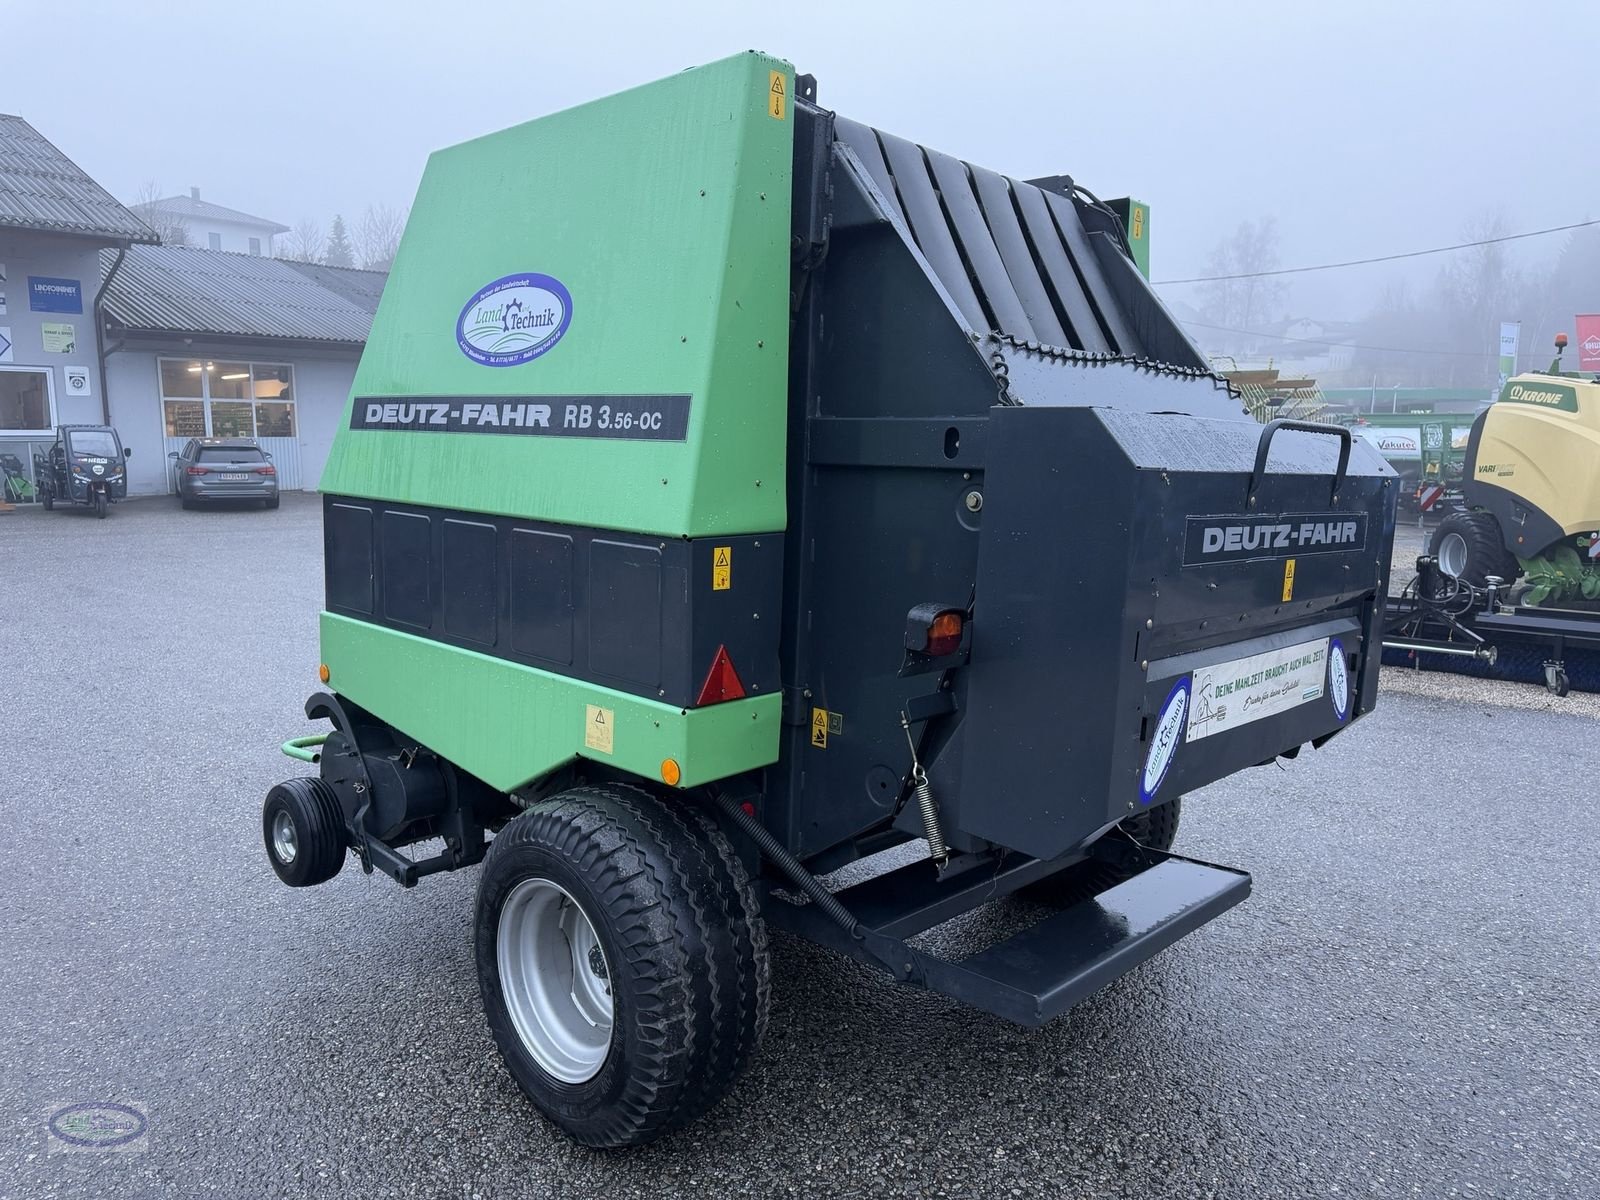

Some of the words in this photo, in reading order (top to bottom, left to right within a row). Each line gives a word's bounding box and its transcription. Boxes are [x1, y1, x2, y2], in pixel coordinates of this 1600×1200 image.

[475, 303, 504, 325] Land
[511, 308, 555, 330] Technik
[1520, 390, 1563, 404] KRONE
[365, 403, 552, 428] DEUTZ-FAHR
[563, 406, 592, 429] RB
[597, 405, 663, 430] 3.56-OC
[1202, 521, 1357, 553] DEUTZ-FAHR
[1215, 682, 1234, 699] DEINE
[1234, 672, 1264, 692] MAHLZEIT
[1265, 663, 1288, 680] BRAUCHT
[1289, 659, 1302, 673] AUCH
[1302, 655, 1312, 667] MAL
[1148, 744, 1162, 777] Land
[1164, 696, 1184, 740] Technik
